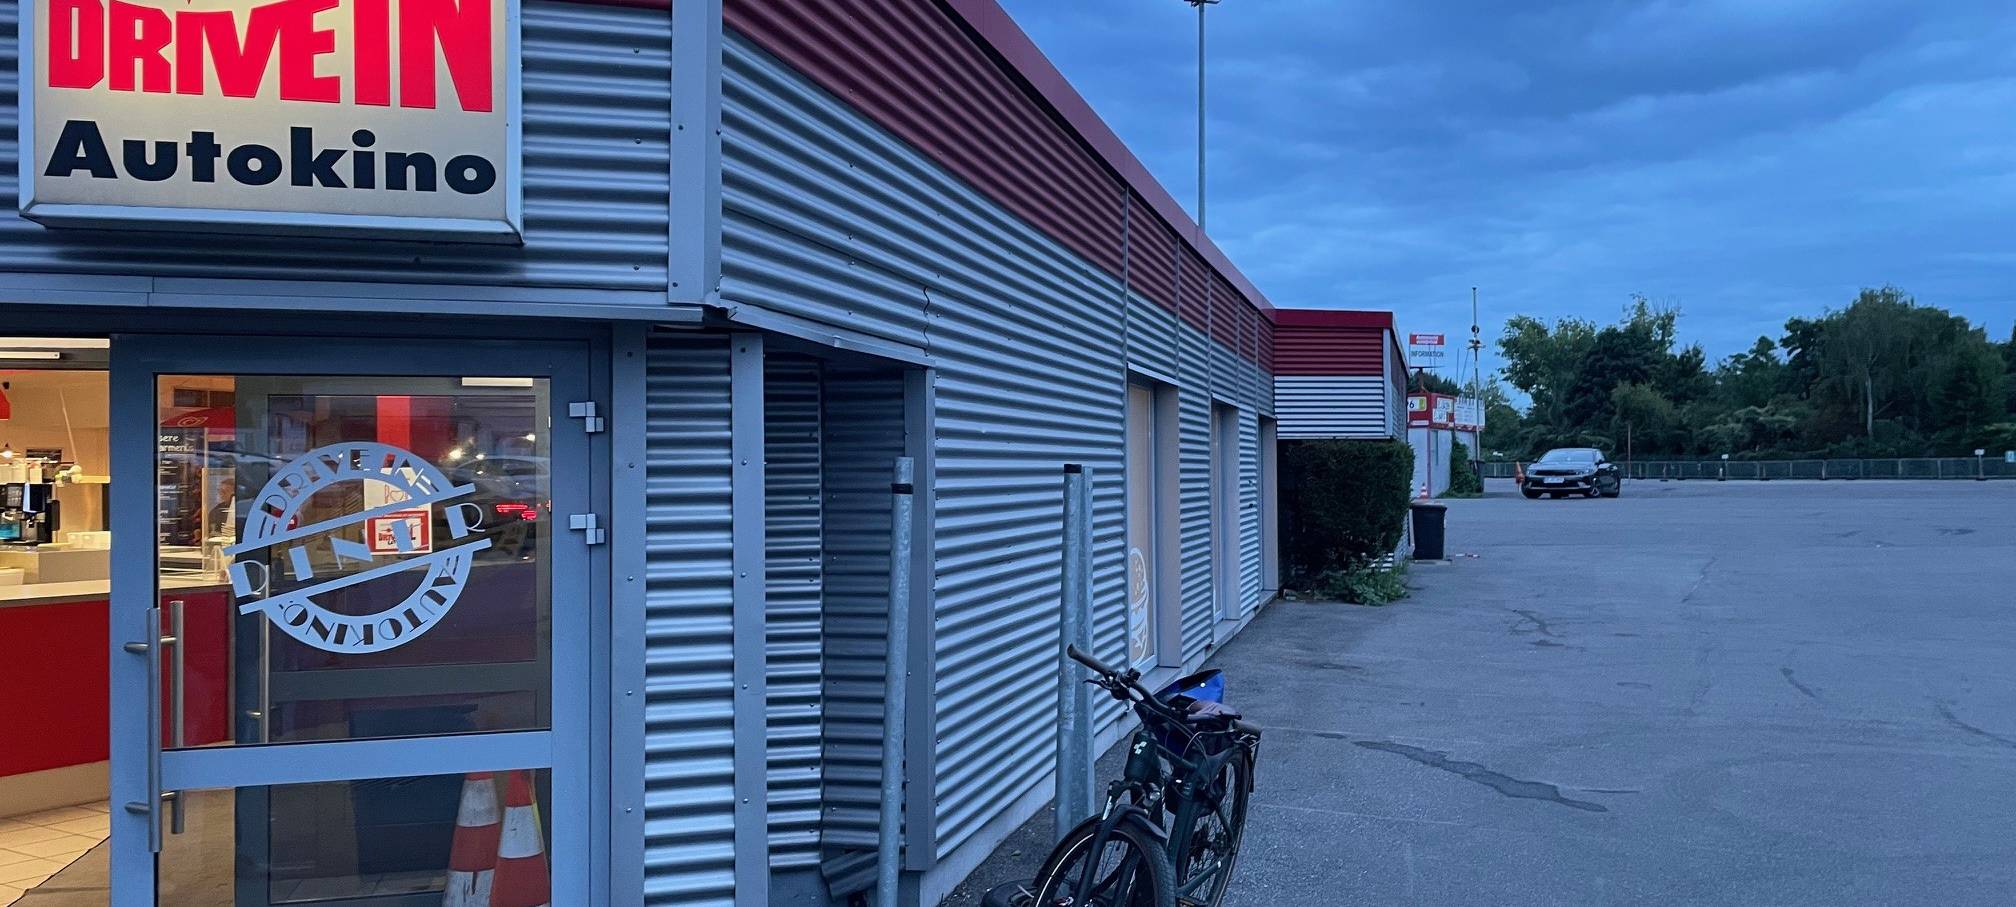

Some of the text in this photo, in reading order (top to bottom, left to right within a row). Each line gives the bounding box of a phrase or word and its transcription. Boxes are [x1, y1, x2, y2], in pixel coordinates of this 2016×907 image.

[44, 119, 497, 195] Autokino
[1410, 350, 1444, 358] INFORMATION
[260, 449, 424, 518] DRIVE IN
[283, 568, 457, 646] AUTOKINO
